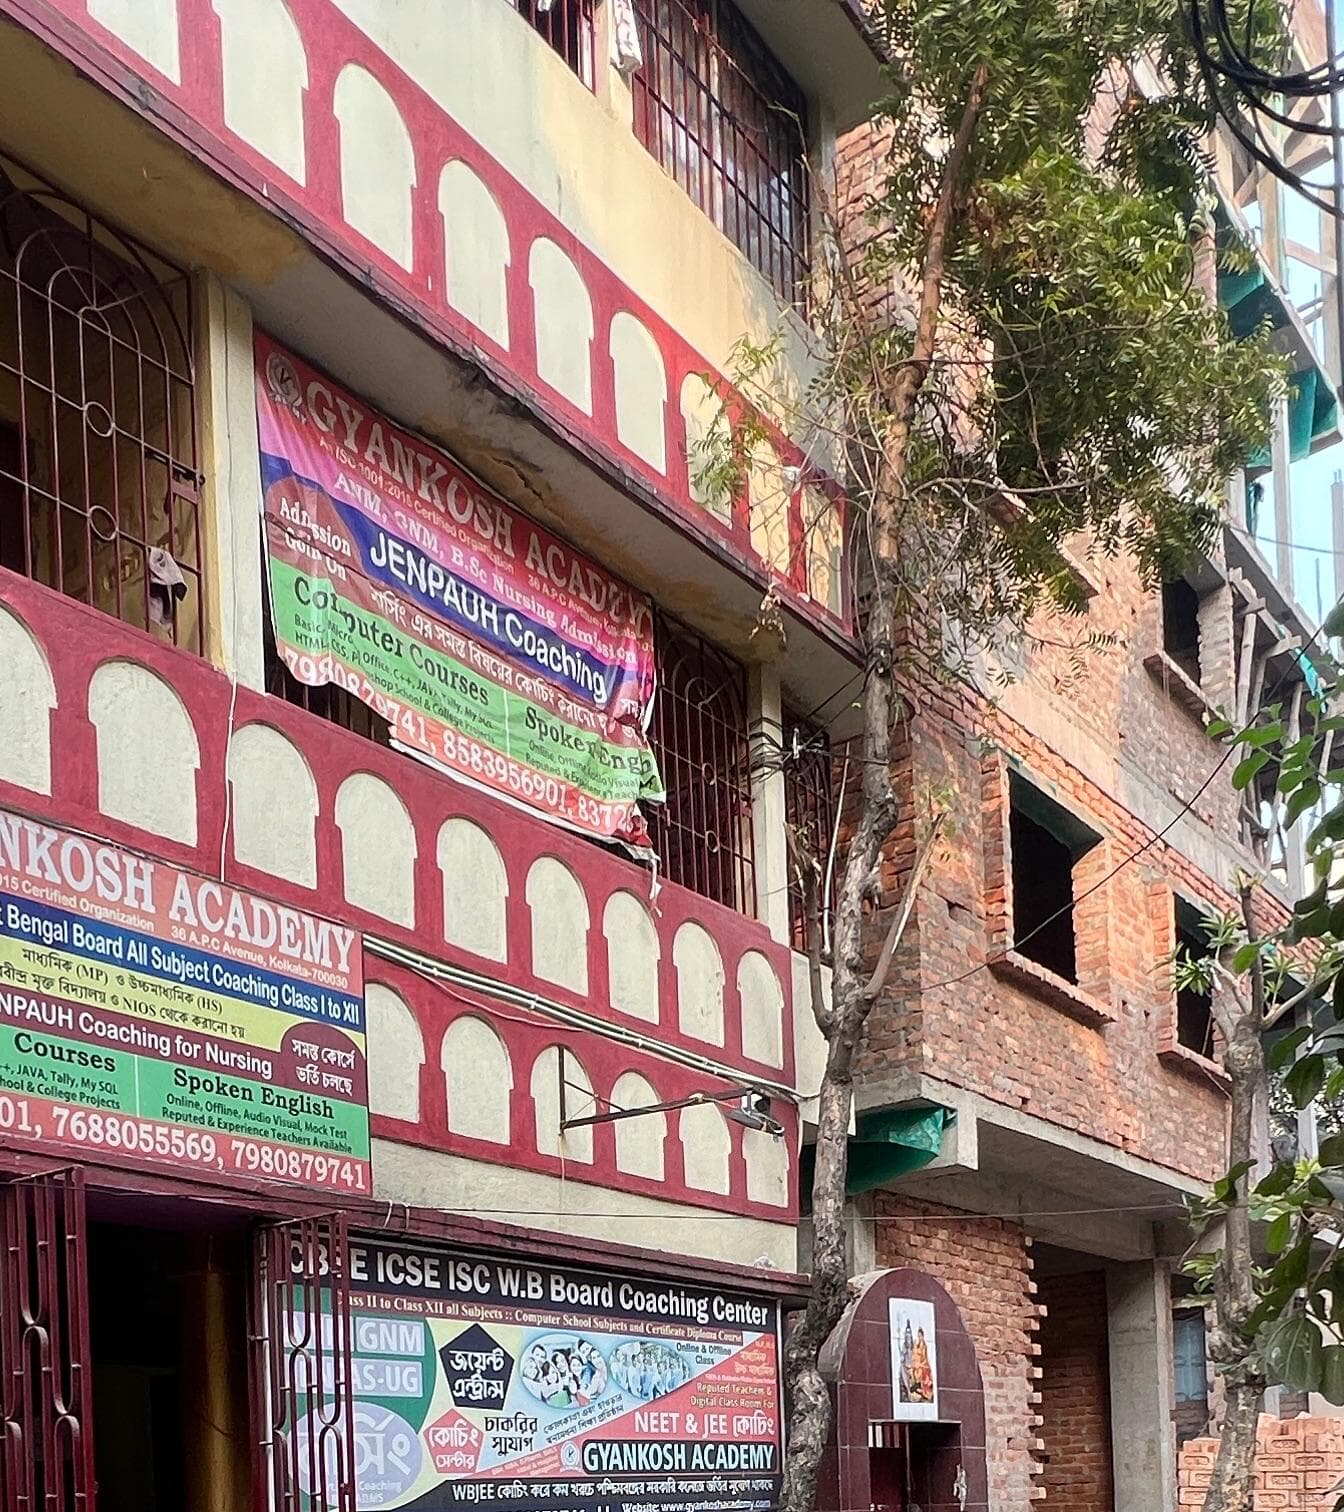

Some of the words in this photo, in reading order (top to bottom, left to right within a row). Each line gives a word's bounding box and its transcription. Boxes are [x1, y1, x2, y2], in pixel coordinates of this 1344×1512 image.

[370, 532, 499, 629] JENPAUH
[504, 614, 606, 704] Coaching
[492, 571, 556, 627] Nursing
[21, 878, 77, 911] Certified
[169, 875, 354, 973] ACADEMY
[7, 906, 68, 948] Bengal
[72, 919, 123, 960] Board
[151, 946, 210, 988] Subject
[213, 964, 279, 1007] Coaching
[281, 983, 318, 1013] Class
[22, 947, 73, 973] মাধ্যমিক
[197, 995, 223, 1015] (HS)
[123, 997, 157, 1019] NIOS
[14, 1031, 116, 1073] Courses
[79, 1011, 170, 1057] Coaching
[175, 1035, 201, 1060] for
[206, 1042, 273, 1080] Nursing
[174, 1068, 254, 1102] Spoken
[261, 1085, 334, 1120] English
[52, 1105, 223, 1171] 7688055569,
[231, 1140, 366, 1190] 7980879741
[162, 1106, 206, 1127] Reputed
[217, 1117, 270, 1139] Experience
[271, 1127, 311, 1148] Teachers
[376, 1251, 440, 1289] ICSE
[448, 1260, 491, 1294] ISC
[550, 1274, 614, 1308] Board
[619, 1282, 708, 1324] Coaching
[712, 1296, 768, 1326] Center
[360, 1322, 424, 1353] GNM
[634, 1412, 680, 1433] NEET
[584, 1443, 686, 1471] GYANKOSH
[692, 1443, 774, 1469] ACADEMY
